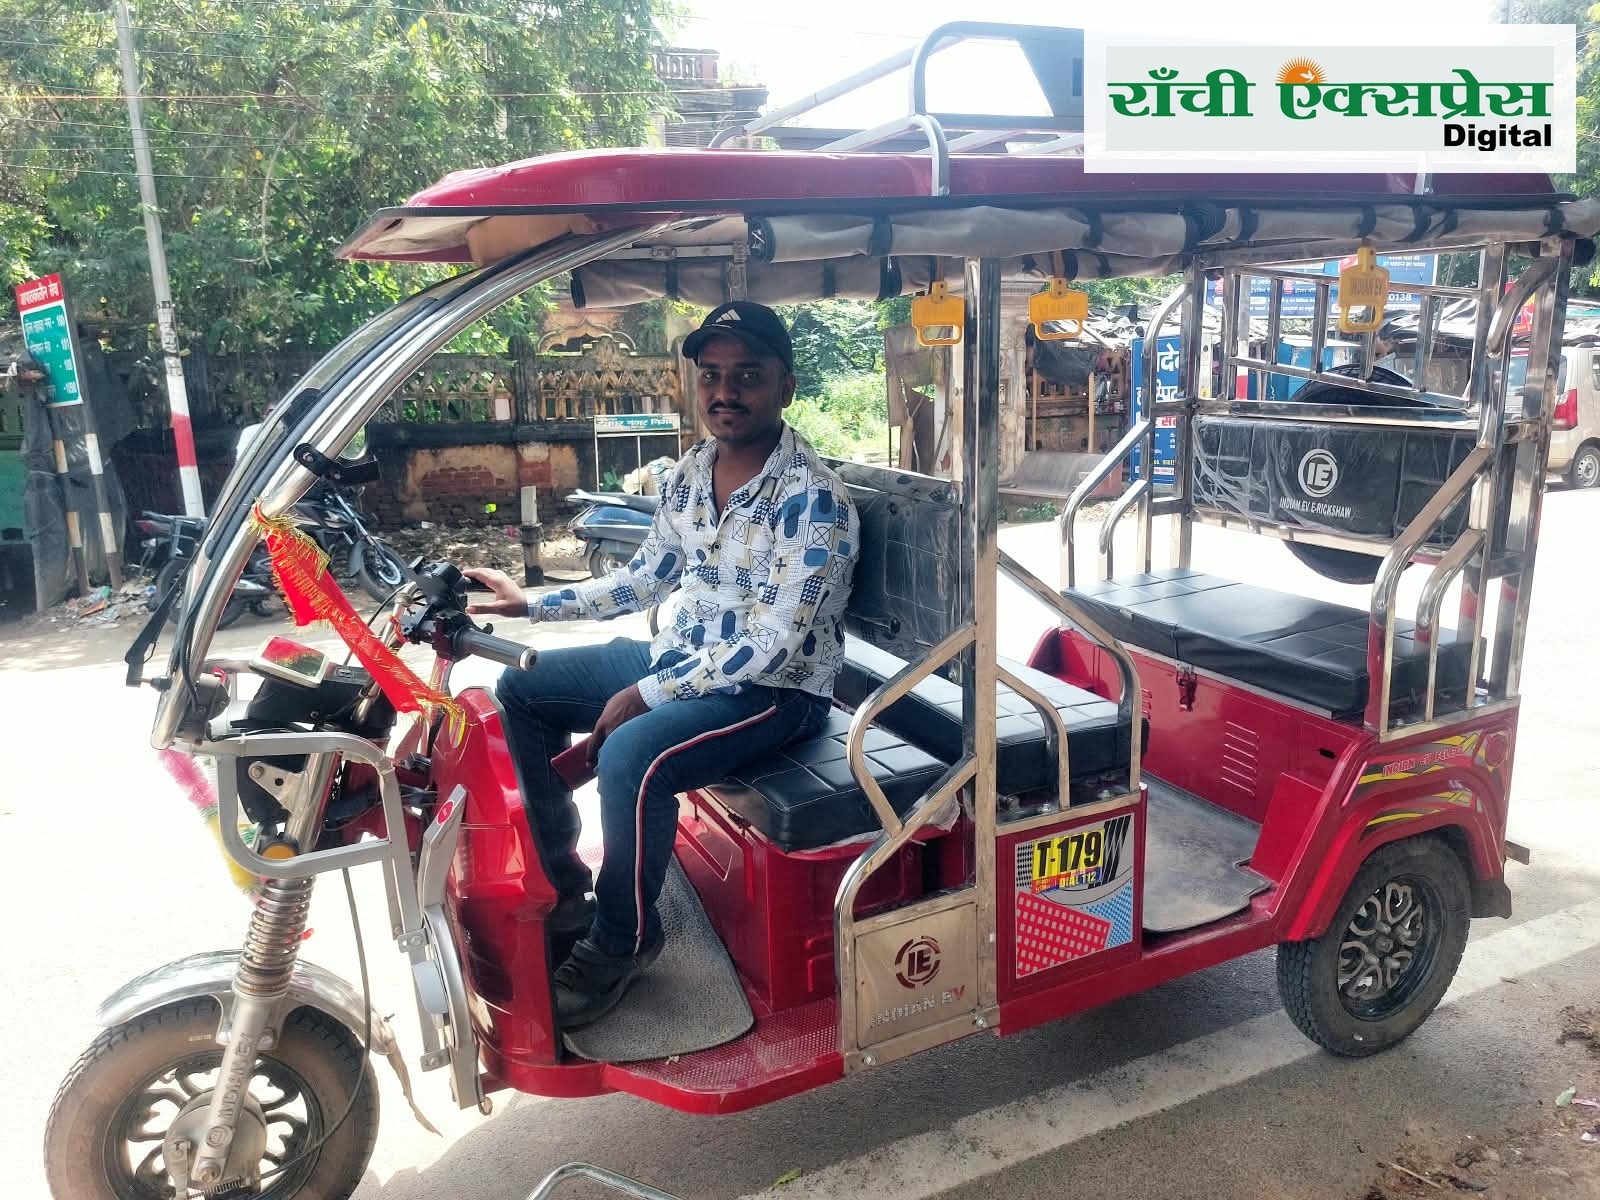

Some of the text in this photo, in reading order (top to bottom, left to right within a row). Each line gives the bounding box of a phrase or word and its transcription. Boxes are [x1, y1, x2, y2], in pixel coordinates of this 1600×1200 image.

[1280, 496, 1301, 512] INDIAN
[1301, 500, 1311, 513] EV
[1037, 831, 1103, 878] T-179
